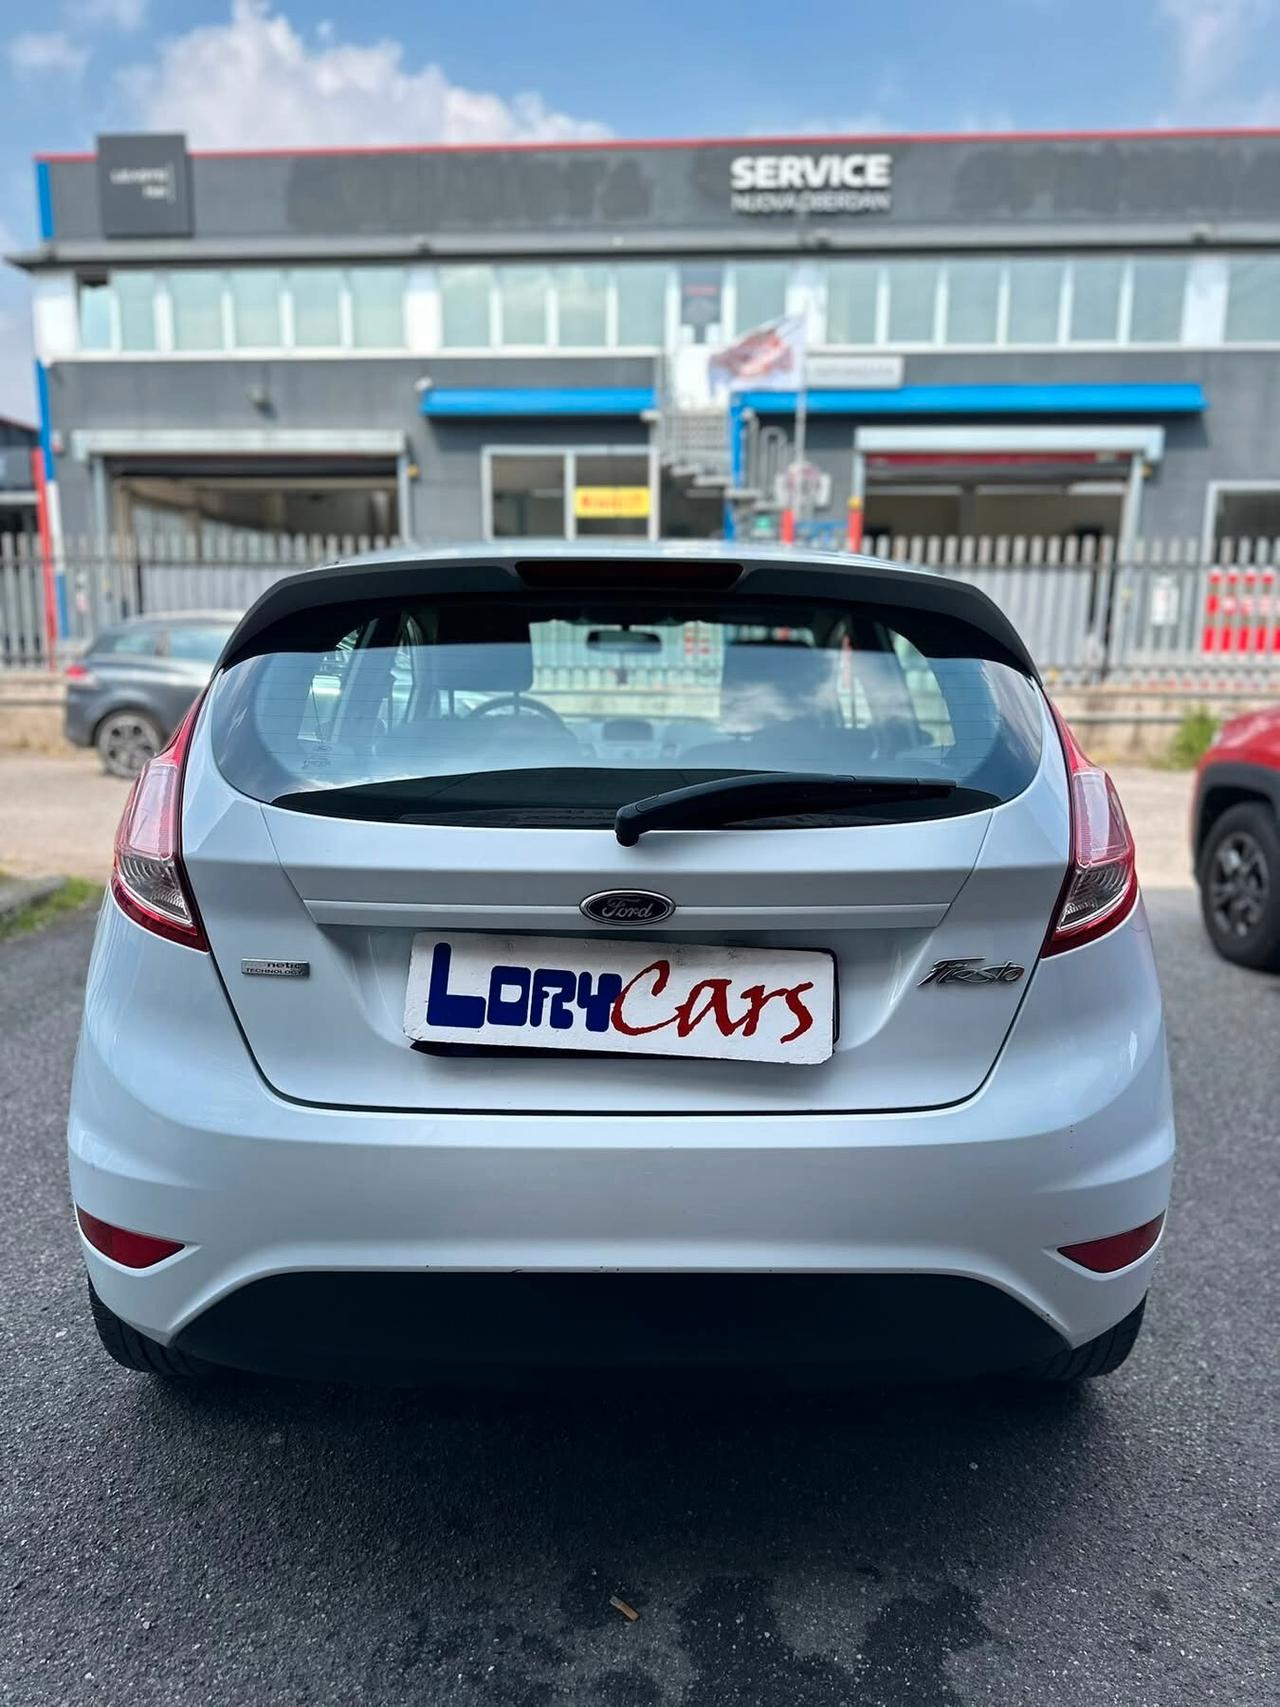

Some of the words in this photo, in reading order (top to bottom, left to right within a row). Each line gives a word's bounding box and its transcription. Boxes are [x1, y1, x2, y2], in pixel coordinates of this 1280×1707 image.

[730, 154, 892, 189] SERVICE
[601, 897, 653, 918] Ford
[246, 967, 304, 975] TECHNOLOGY
[916, 956, 1025, 986] Fiesta
